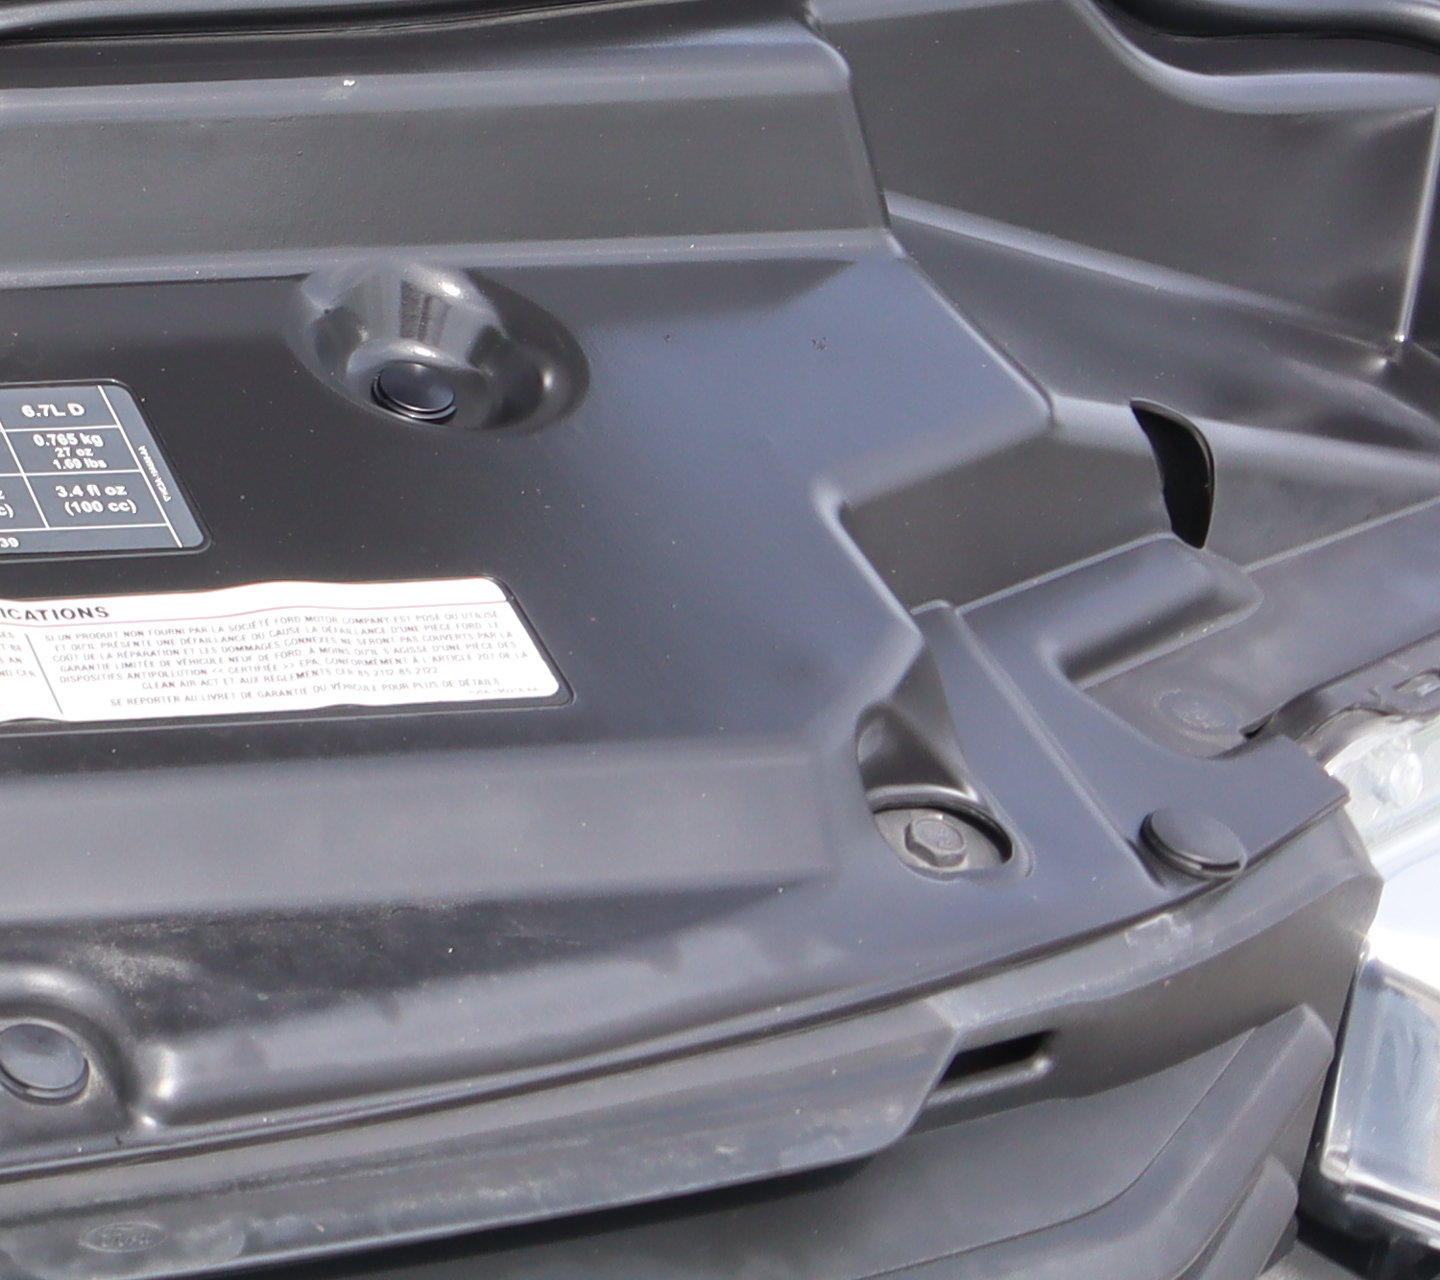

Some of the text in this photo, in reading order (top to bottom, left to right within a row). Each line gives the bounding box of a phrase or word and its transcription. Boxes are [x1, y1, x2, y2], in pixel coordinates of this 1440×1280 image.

[21, 403, 85, 417] 6.7L D
[33, 433, 104, 447] 0.765 kg
[55, 447, 93, 458] 27 oz
[53, 458, 107, 469] 1.69 lbs
[55, 484, 127, 498] 3.4 fl oz
[65, 499, 137, 516] (100 cc)
